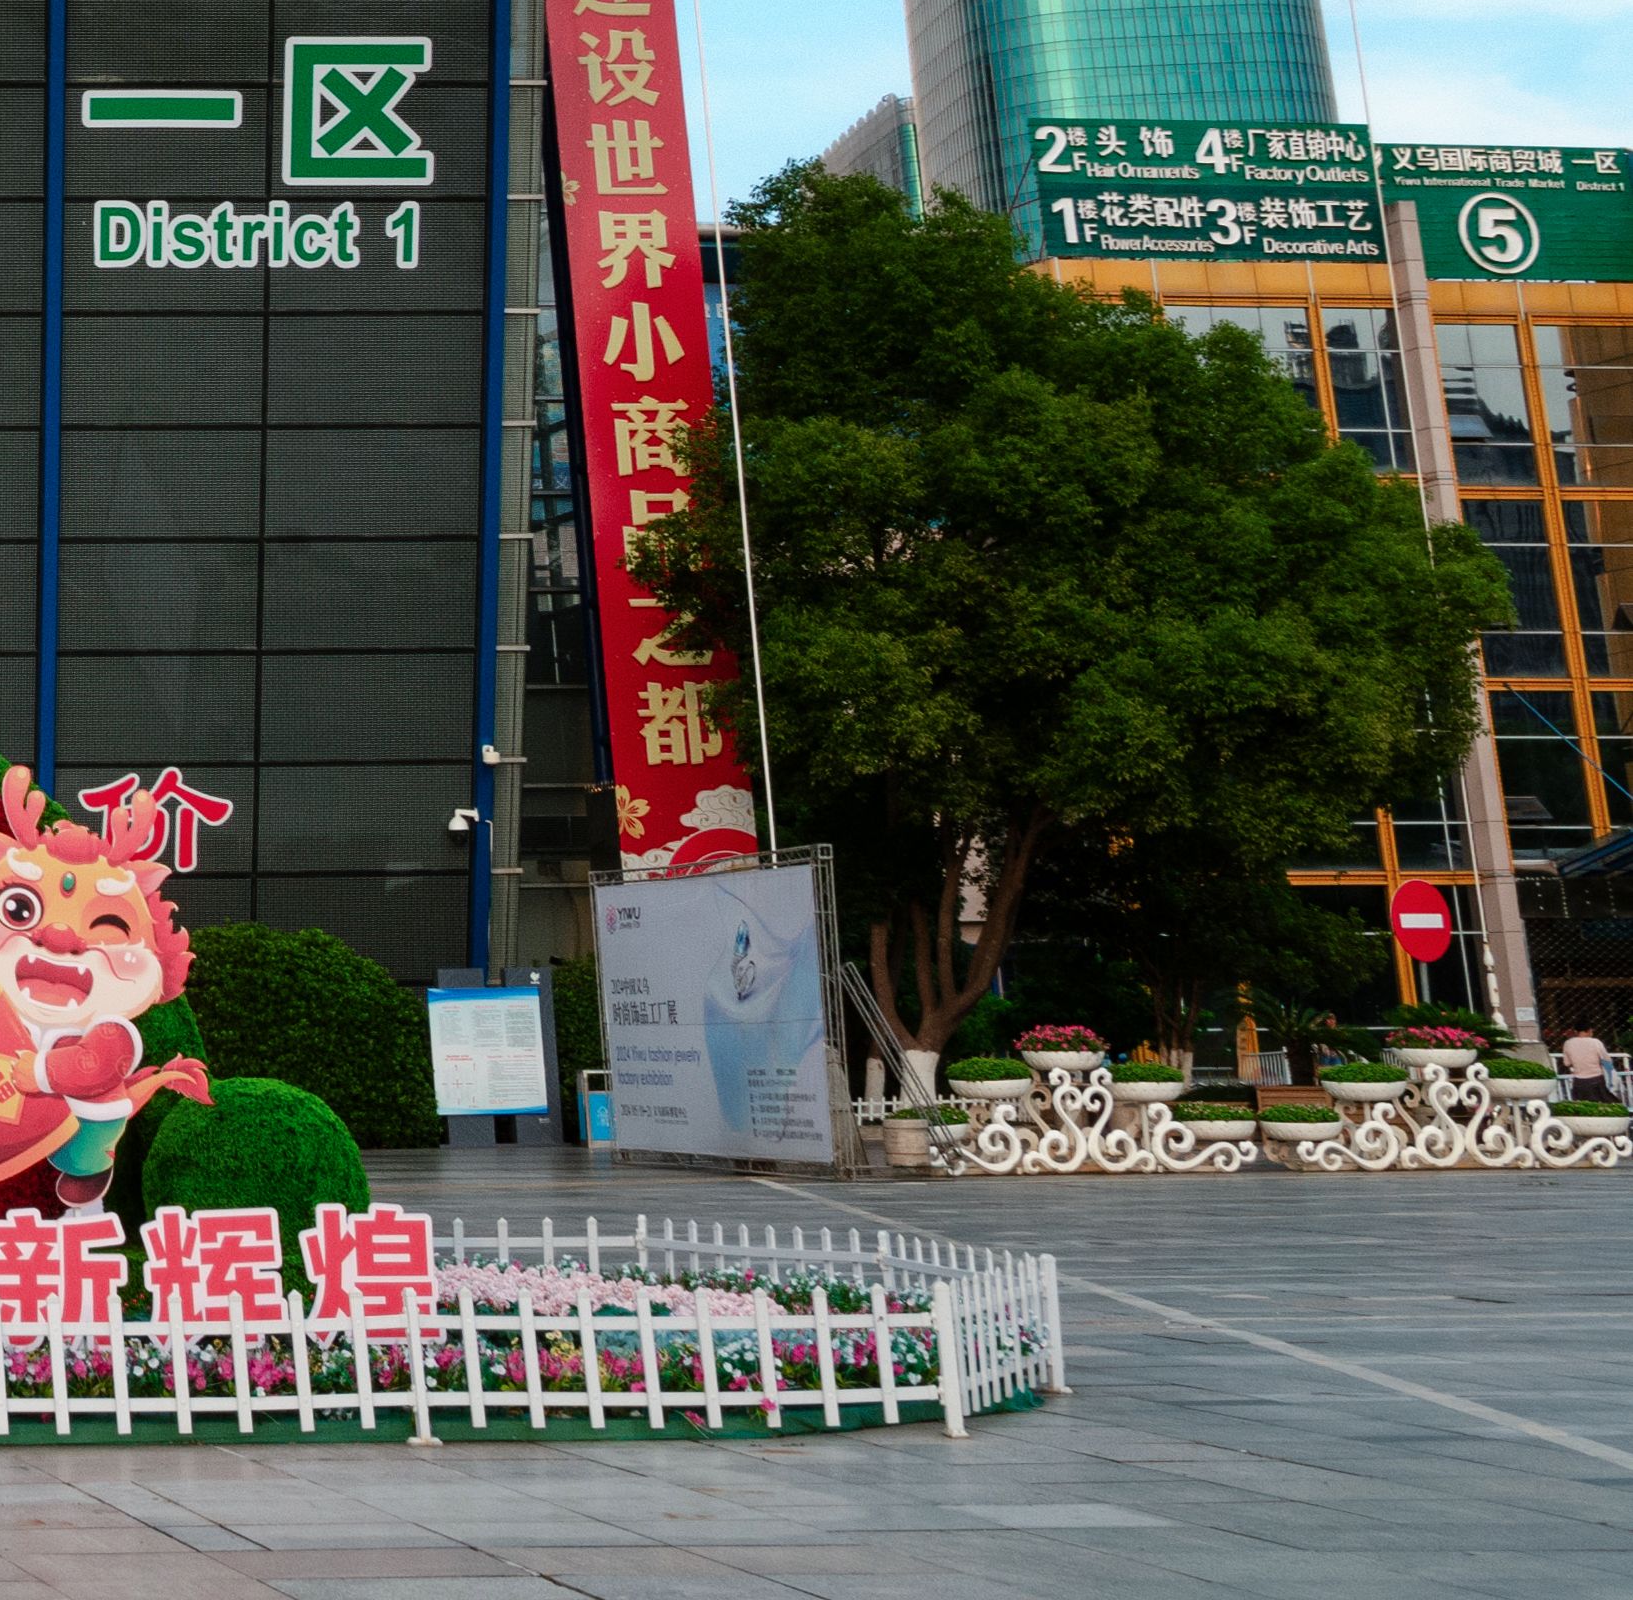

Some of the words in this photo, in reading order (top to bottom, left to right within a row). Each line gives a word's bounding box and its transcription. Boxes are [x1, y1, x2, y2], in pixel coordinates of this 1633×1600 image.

[82, 36, 434, 185] 一区
[1247, 129, 1366, 162] 厂家直销中心
[1086, 162, 1117, 178] Hair
[1118, 162, 1201, 179] Ornaments
[1391, 148, 1563, 174] 义乌国际商贸城
[1571, 152, 1621, 174] 一区
[1244, 165, 1305, 185] Factory
[1306, 165, 1369, 182] Outlets
[1423, 177, 1491, 187] International
[1496, 178, 1525, 188] Trade
[1528, 179, 1565, 189] Market
[1576, 181, 1618, 192] District
[1097, 192, 1207, 228] 花类配件
[1260, 197, 1373, 231] 装饰工艺
[94, 200, 360, 268] District
[385, 201, 420, 268] 1
[1142, 235, 1215, 253] Accessories
[1262, 238, 1345, 254] Decorative
[1345, 239, 1379, 256] Arts
